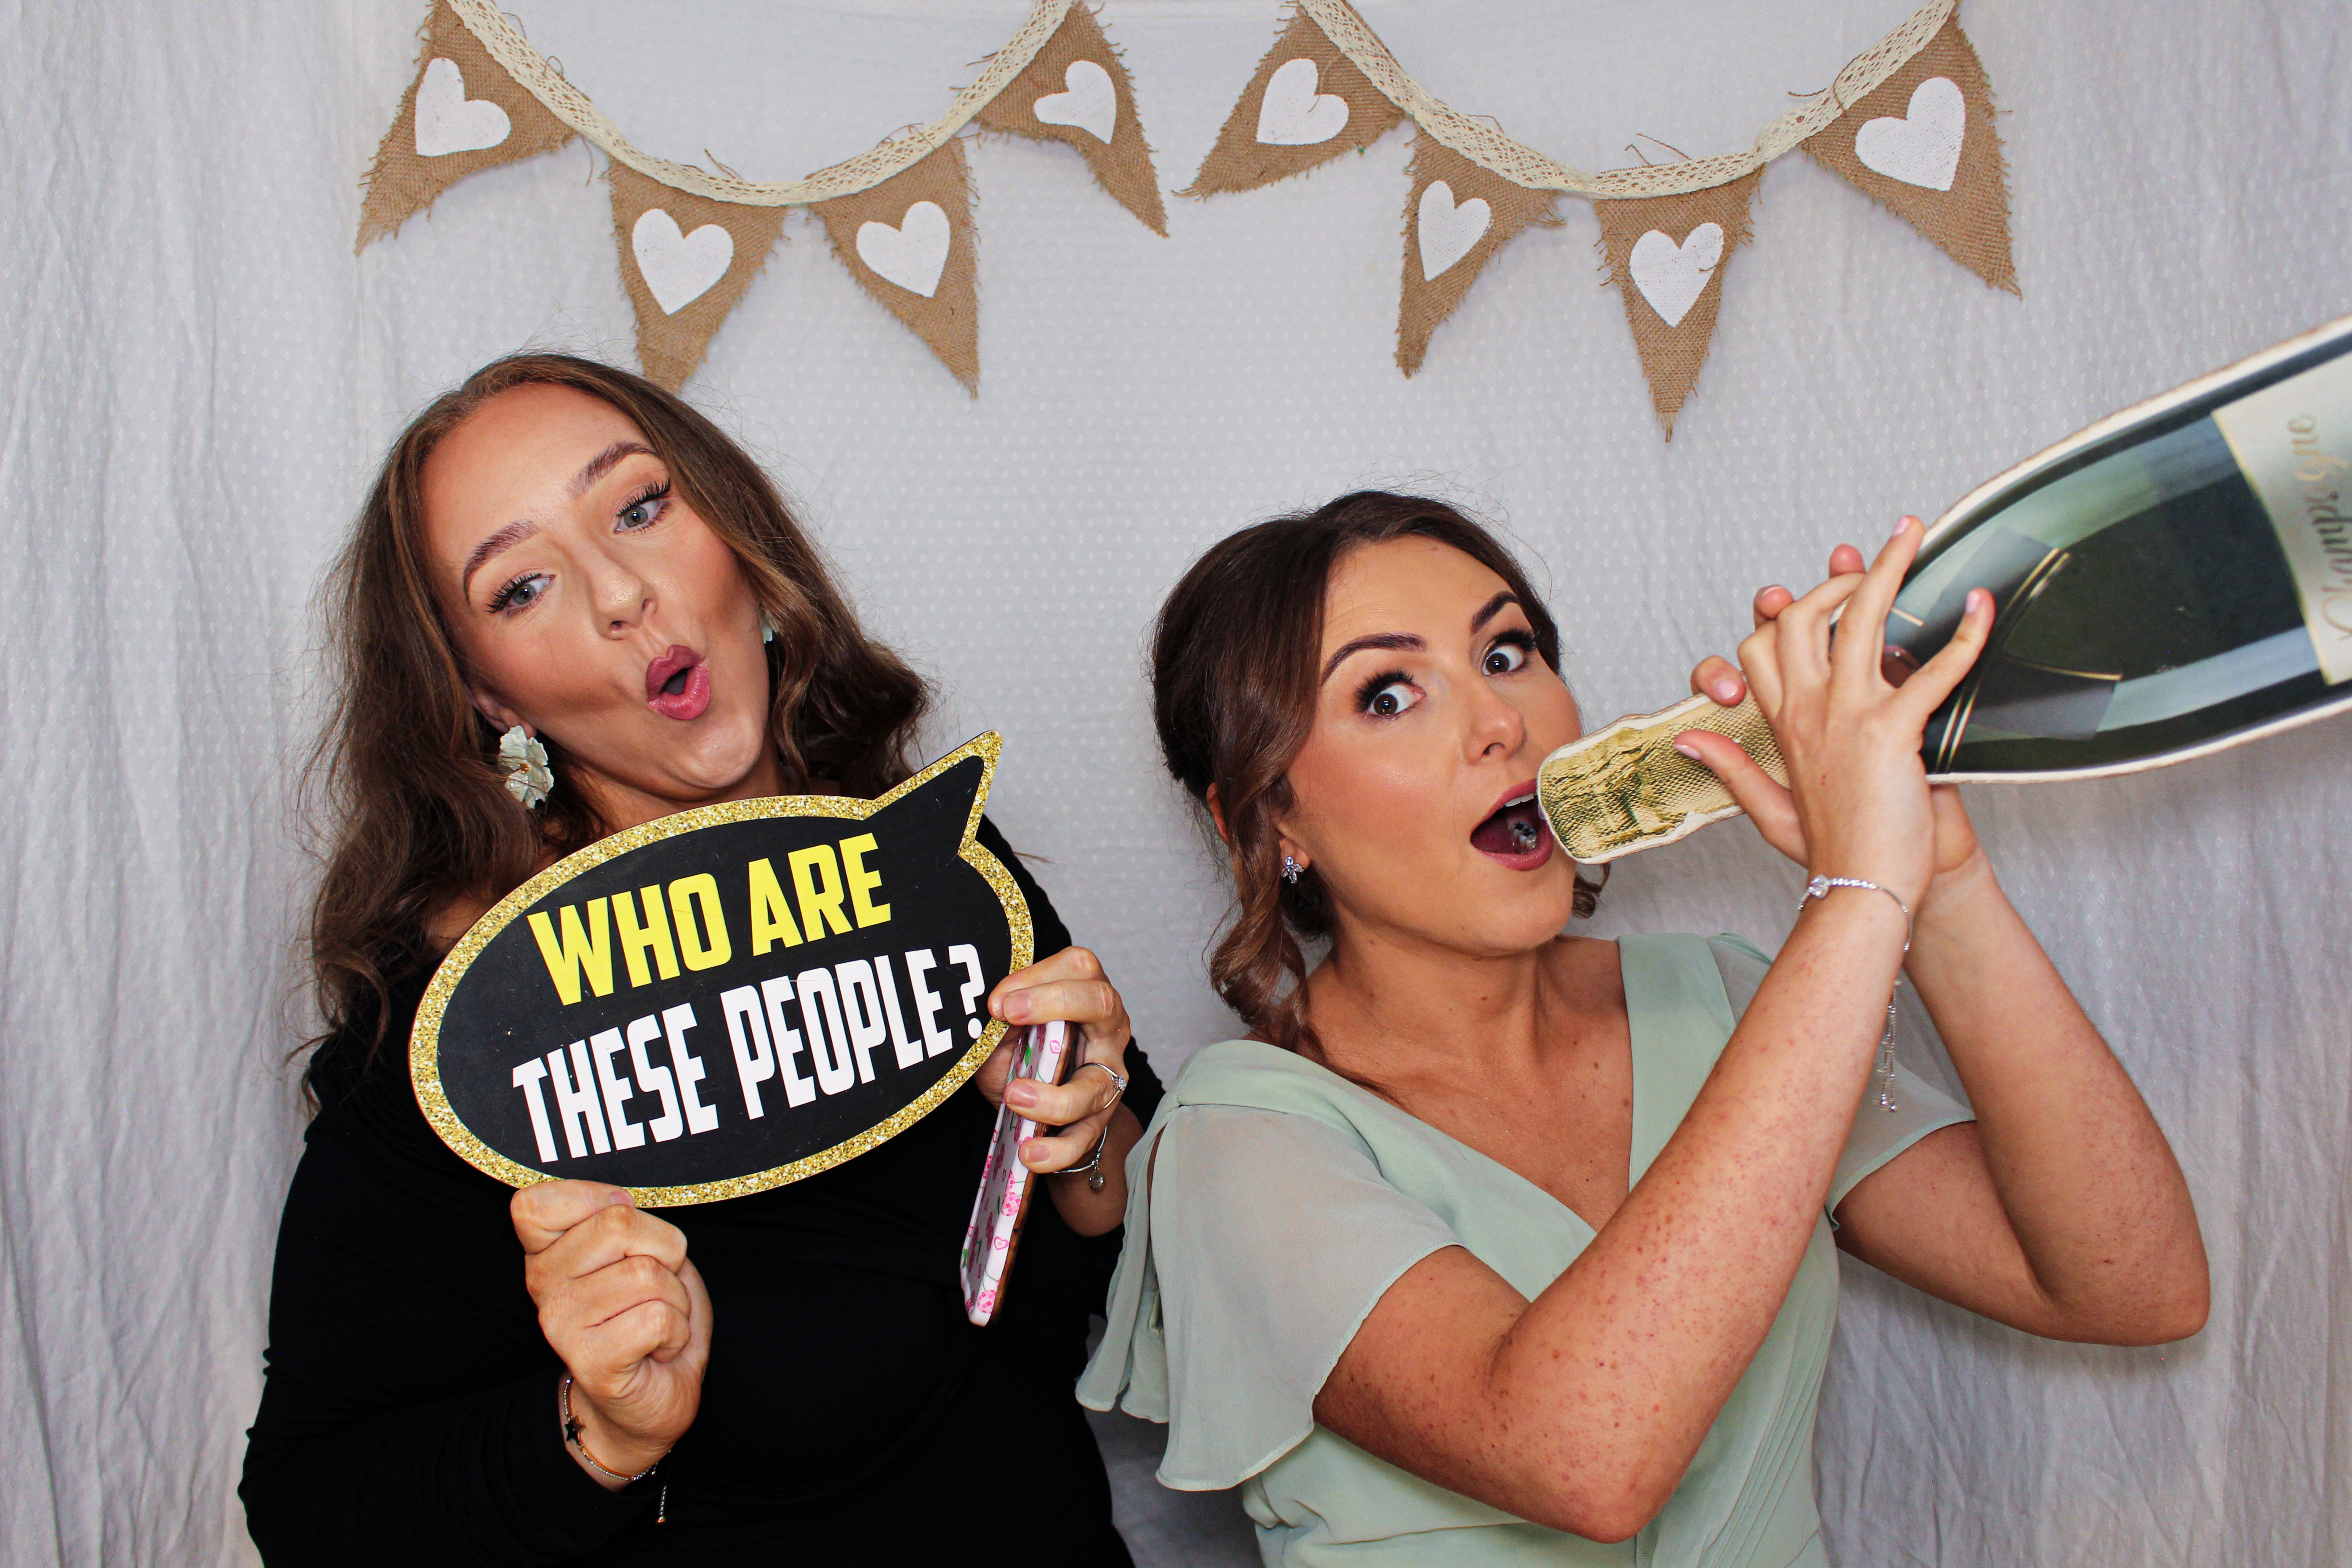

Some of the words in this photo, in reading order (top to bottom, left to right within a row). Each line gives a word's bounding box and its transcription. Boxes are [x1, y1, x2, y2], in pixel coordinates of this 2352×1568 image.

[526, 872, 732, 1006] WHO
[748, 832, 892, 957] ARE
[512, 1002, 719, 1163] THESE
[720, 943, 985, 1120] PEOPLE?
